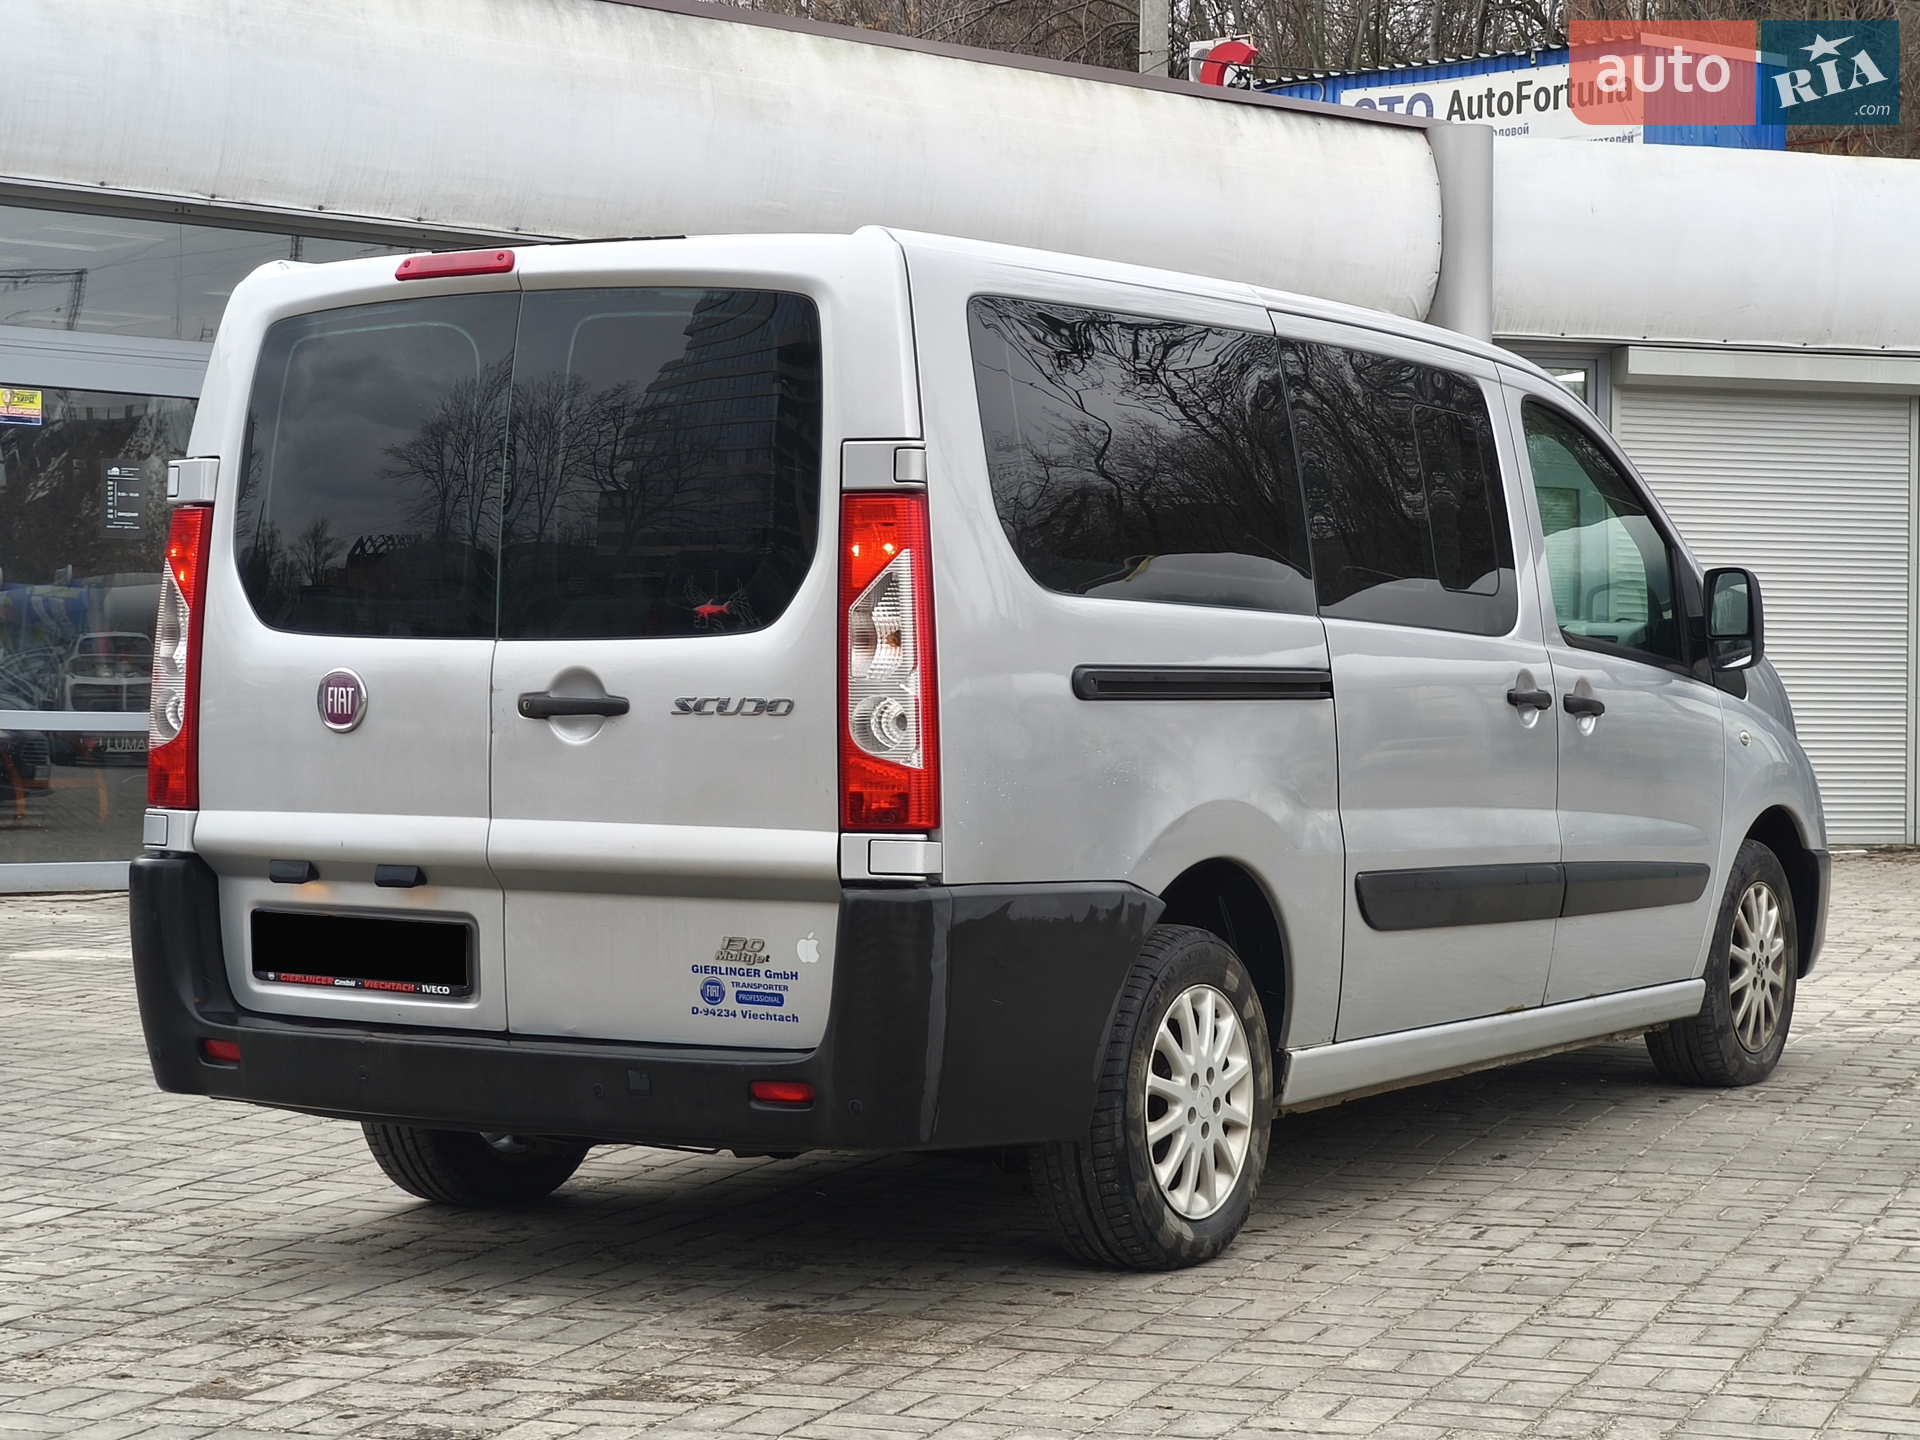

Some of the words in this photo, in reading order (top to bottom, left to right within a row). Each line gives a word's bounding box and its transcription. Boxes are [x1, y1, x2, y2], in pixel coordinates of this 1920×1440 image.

[1446, 75, 1633, 121] AutoFortuna
[327, 686, 355, 714] FIAT
[670, 696, 795, 716] SCUDO
[720, 937, 765, 952] 130
[691, 964, 761, 978] GIERLINGER
[764, 969, 799, 981] GmbH
[280, 973, 334, 985] GIERLINGER
[364, 980, 415, 992] VIECHTACH
[421, 984, 451, 995] IVECO
[731, 981, 789, 992] TRANSPORTER
[738, 993, 781, 1004] PROFESSIONAL
[691, 1006, 737, 1018] D-94234
[741, 1010, 799, 1023] Viechtach
